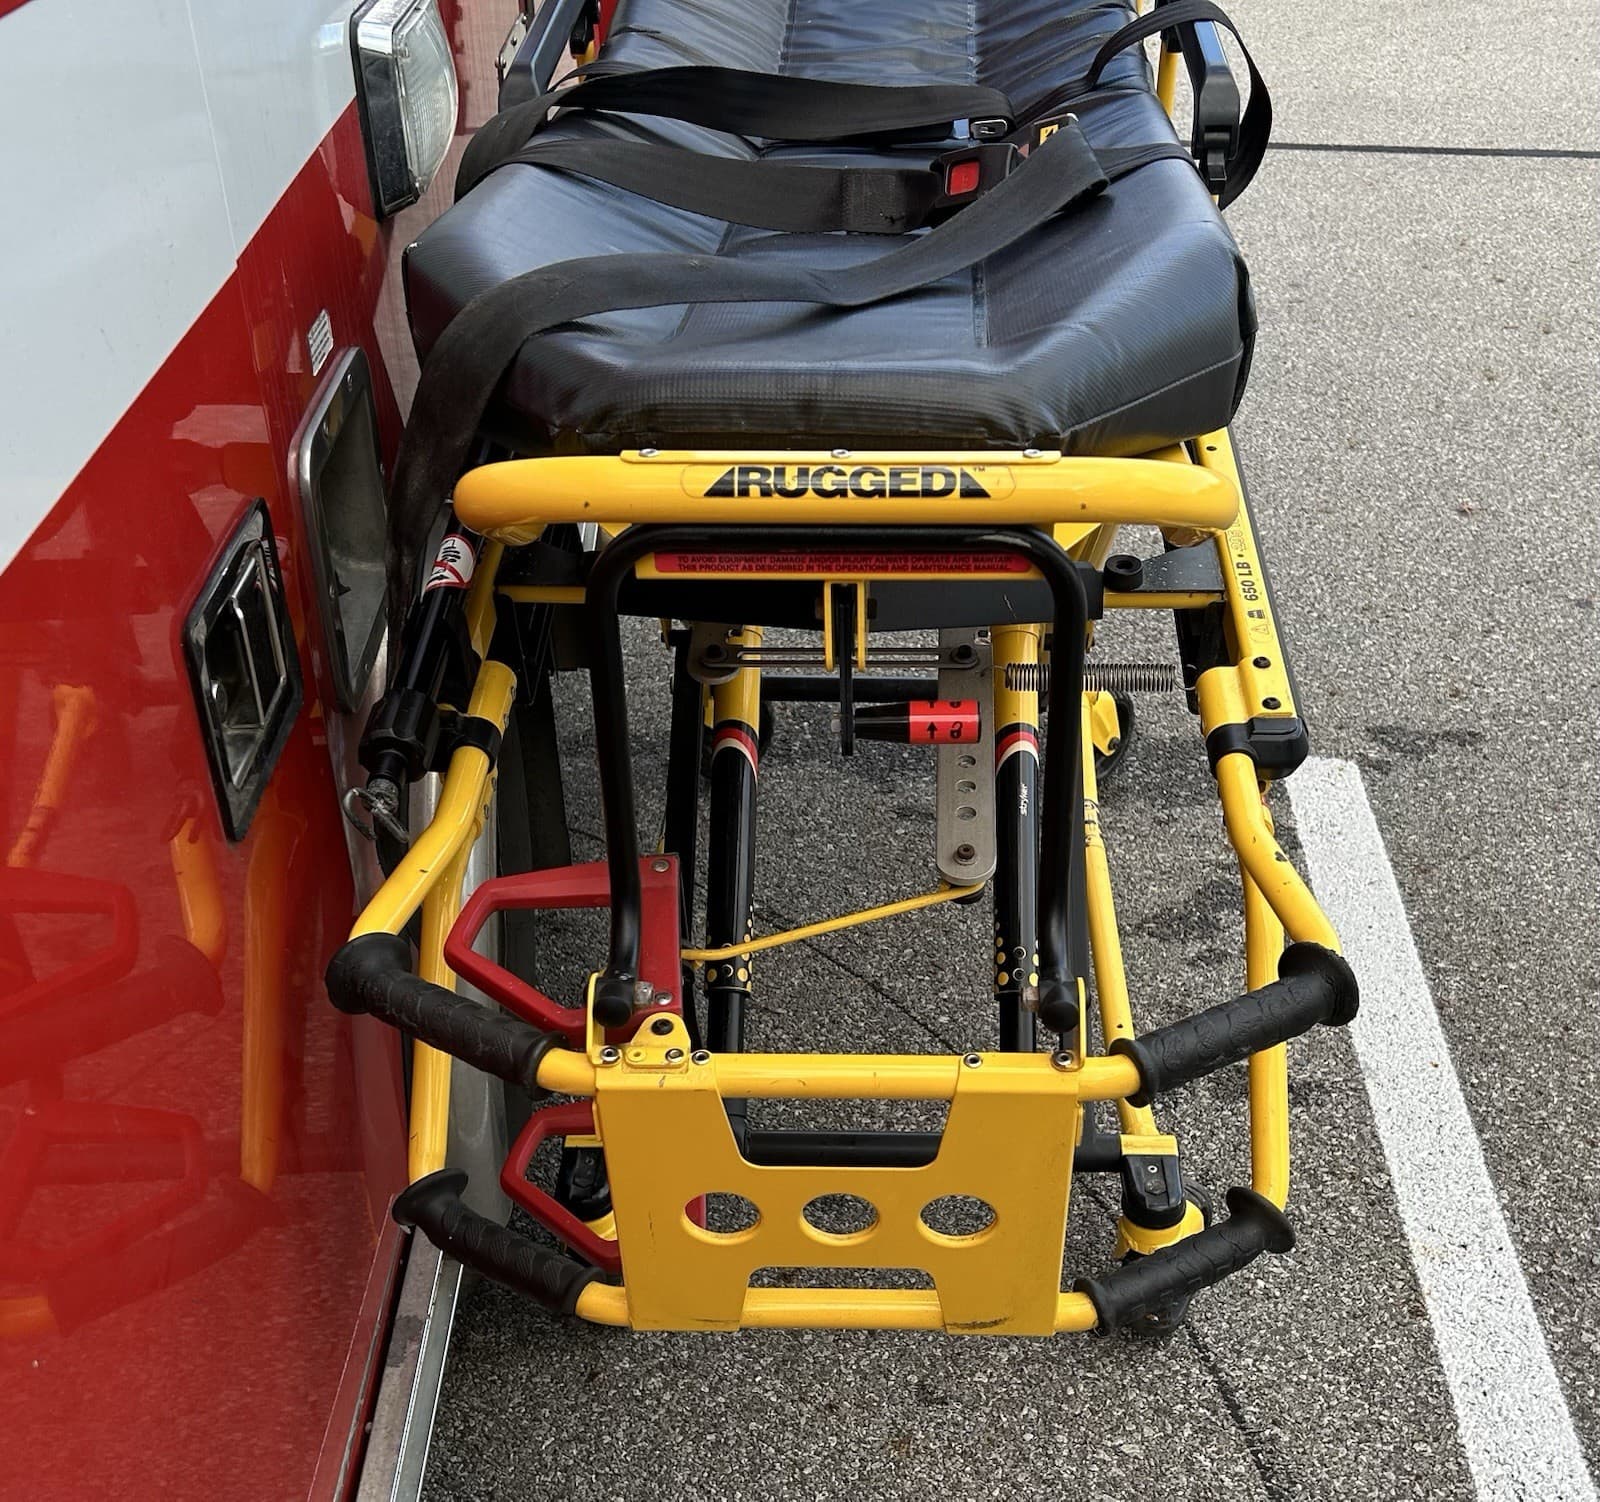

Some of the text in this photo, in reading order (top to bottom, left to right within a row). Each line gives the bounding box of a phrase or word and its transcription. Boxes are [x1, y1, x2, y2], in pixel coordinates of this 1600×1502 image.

[738, 466, 958, 498] RUGGED
[678, 555, 689, 564] TO
[691, 555, 717, 564] AVOID
[718, 555, 767, 564] EQUIPMENT
[770, 555, 806, 564] DAMAGE
[911, 555, 951, 564] OPERATE
[951, 555, 971, 564] AND
[678, 563, 697, 572] THIS
[699, 563, 739, 572] PRODUCT
[741, 563, 754, 572] AS
[755, 563, 802, 572] DESCRIBED
[805, 563, 815, 572] IN
[816, 563, 833, 572] THE
[835, 563, 889, 572] OPERATIONS
[891, 563, 909, 572] AND
[911, 563, 972, 572] MAINTENANCE
[1236, 561, 1253, 577] LB
[1241, 580, 1258, 601] 650
[1018, 783, 1029, 817] stryker
